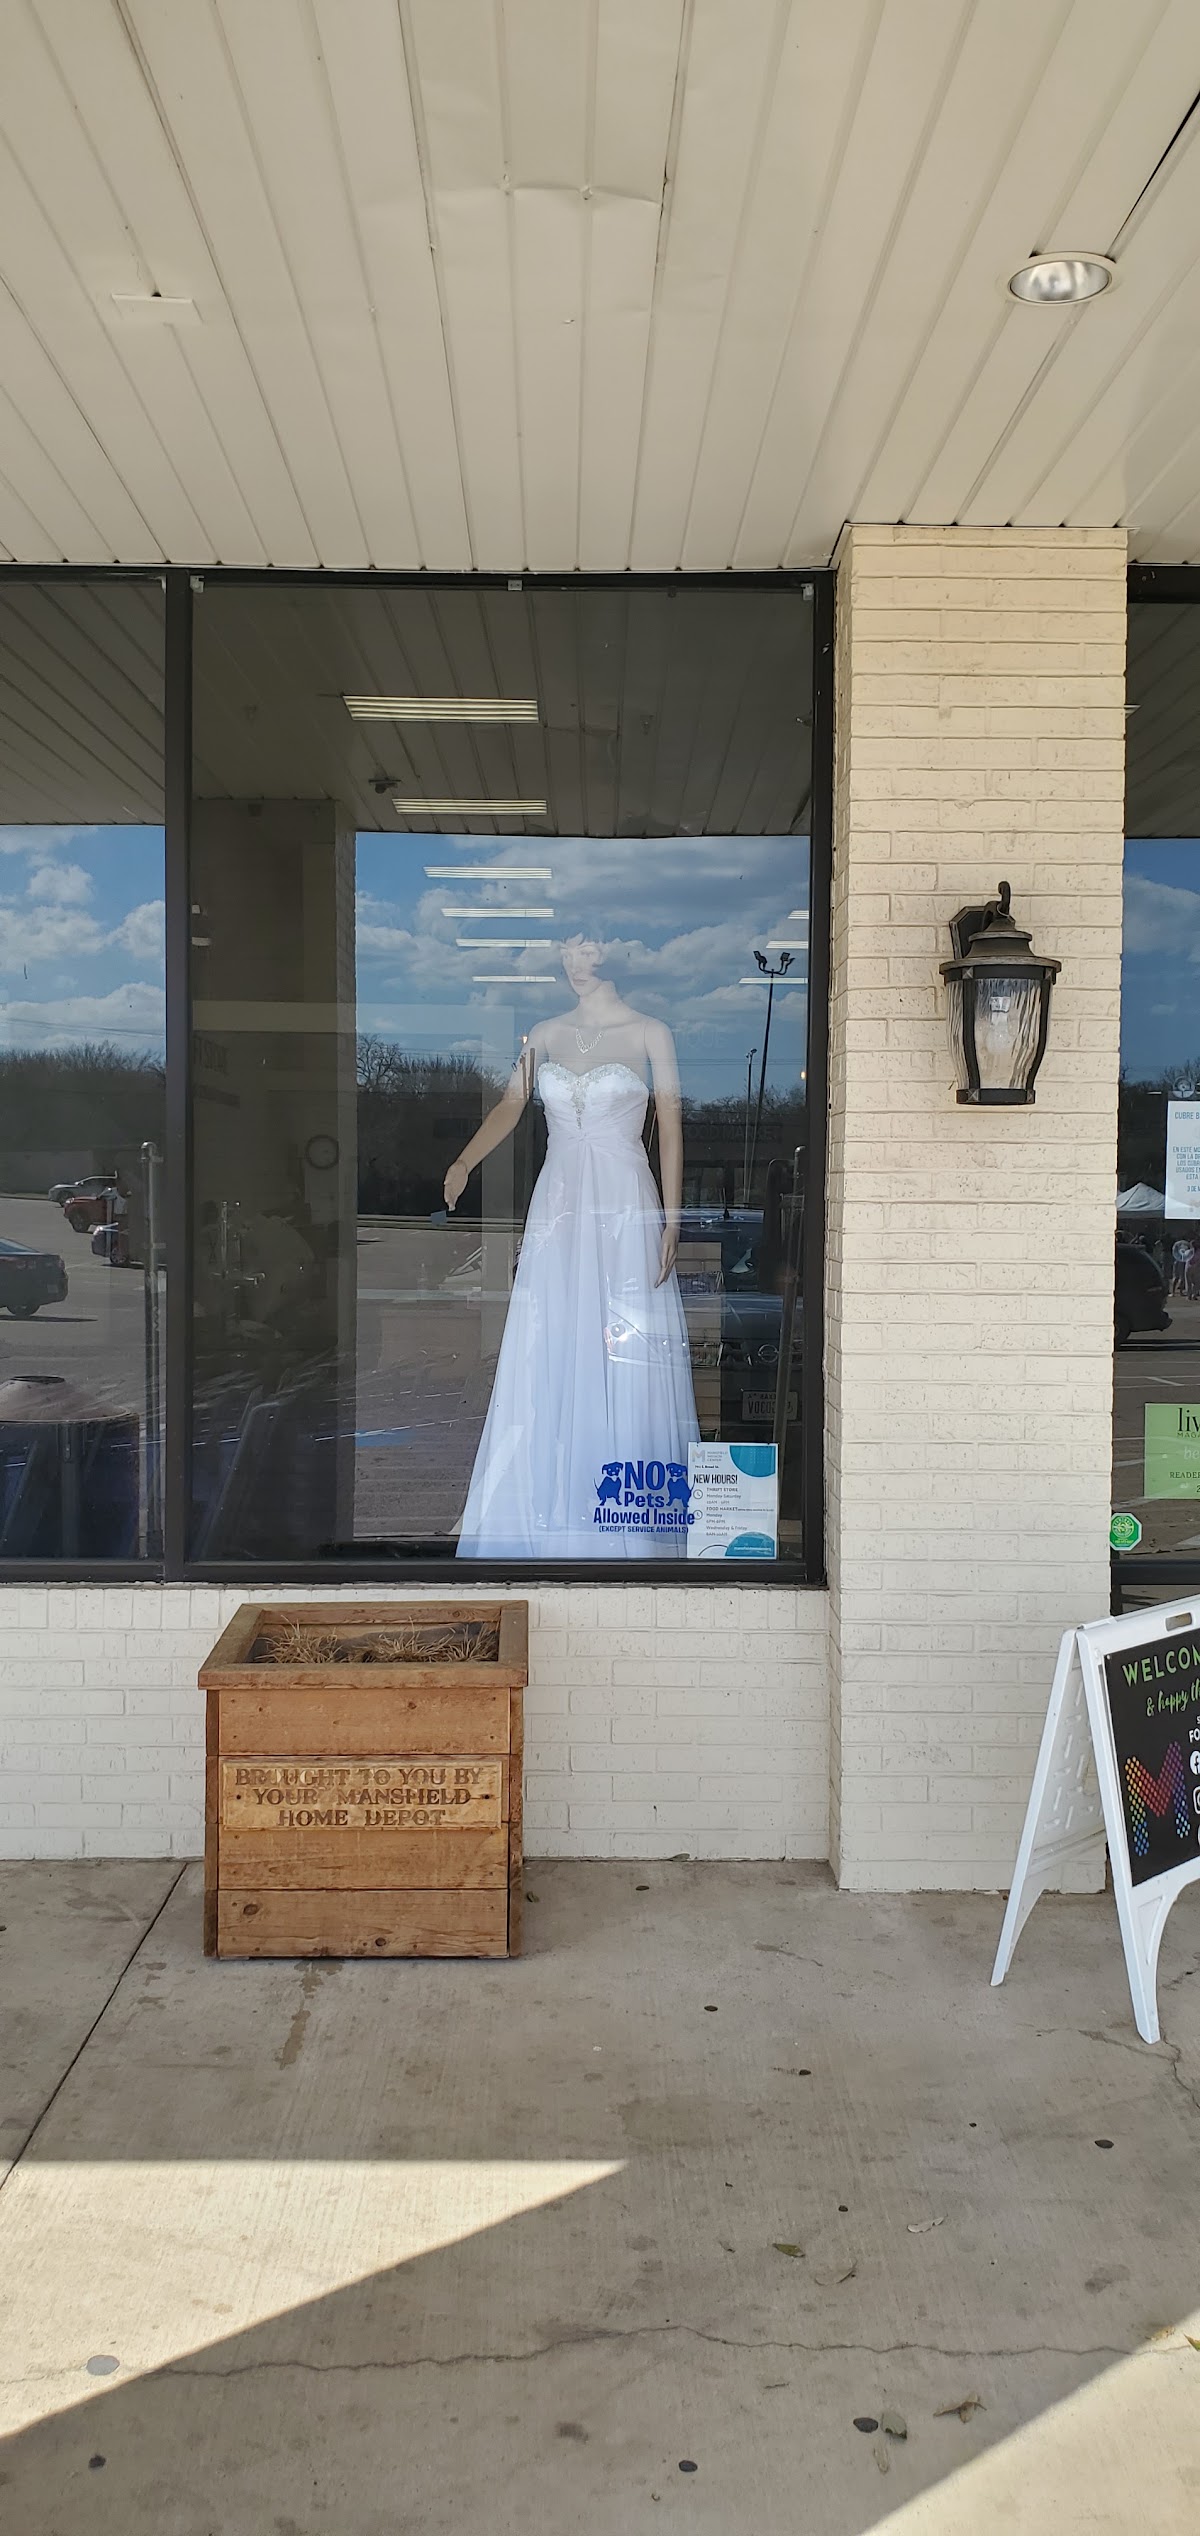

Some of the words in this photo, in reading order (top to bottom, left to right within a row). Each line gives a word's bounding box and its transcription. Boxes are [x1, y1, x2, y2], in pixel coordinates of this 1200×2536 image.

[1175, 1112, 1194, 1120] CUBRE
[624, 1461, 666, 1490] NO
[694, 1474, 710, 1484] NEW
[711, 1474, 738, 1484] HOURS!
[624, 1491, 665, 1508] Pets
[593, 1507, 650, 1524] Allowed
[653, 1508, 695, 1525] Inside
[598, 1525, 626, 1533] (EXCEPT
[627, 1525, 655, 1533] SERVICE
[656, 1526, 689, 1534] ANIMALS)
[1146, 1696, 1155, 1717] &
[1158, 1690, 1188, 1715] happy
[236, 1768, 351, 1786] BROUGHT
[358, 1768, 390, 1785] TO
[399, 1768, 447, 1785] YOU
[454, 1768, 484, 1785] BY
[253, 1788, 318, 1805] YOUR
[336, 1788, 472, 1805] MANSFIELD
[278, 1809, 348, 1827] HOME
[364, 1809, 446, 1827] DEPOT
